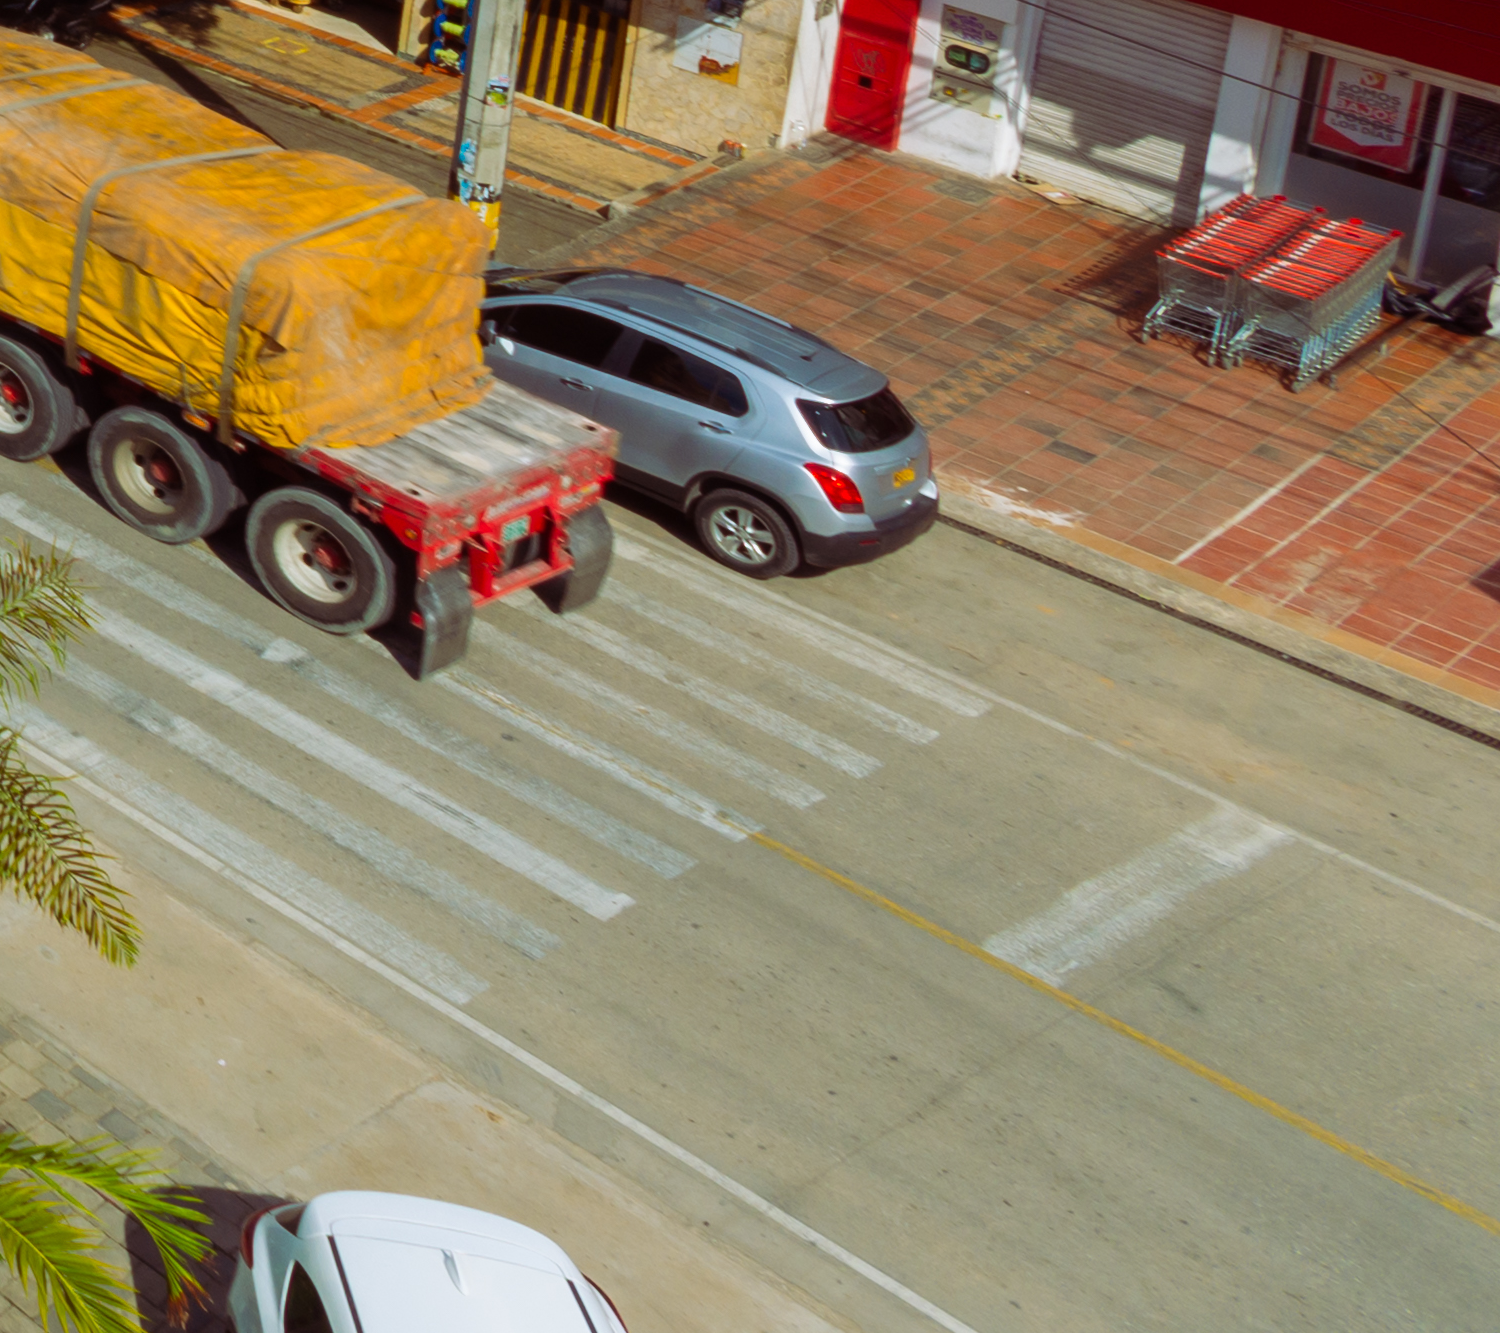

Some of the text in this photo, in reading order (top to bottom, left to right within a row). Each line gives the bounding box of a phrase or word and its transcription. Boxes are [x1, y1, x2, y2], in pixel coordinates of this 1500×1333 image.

[1337, 81, 1402, 106] SOMOS
[1335, 98, 1398, 124] BAJOS
[1330, 118, 1358, 132] LOS
